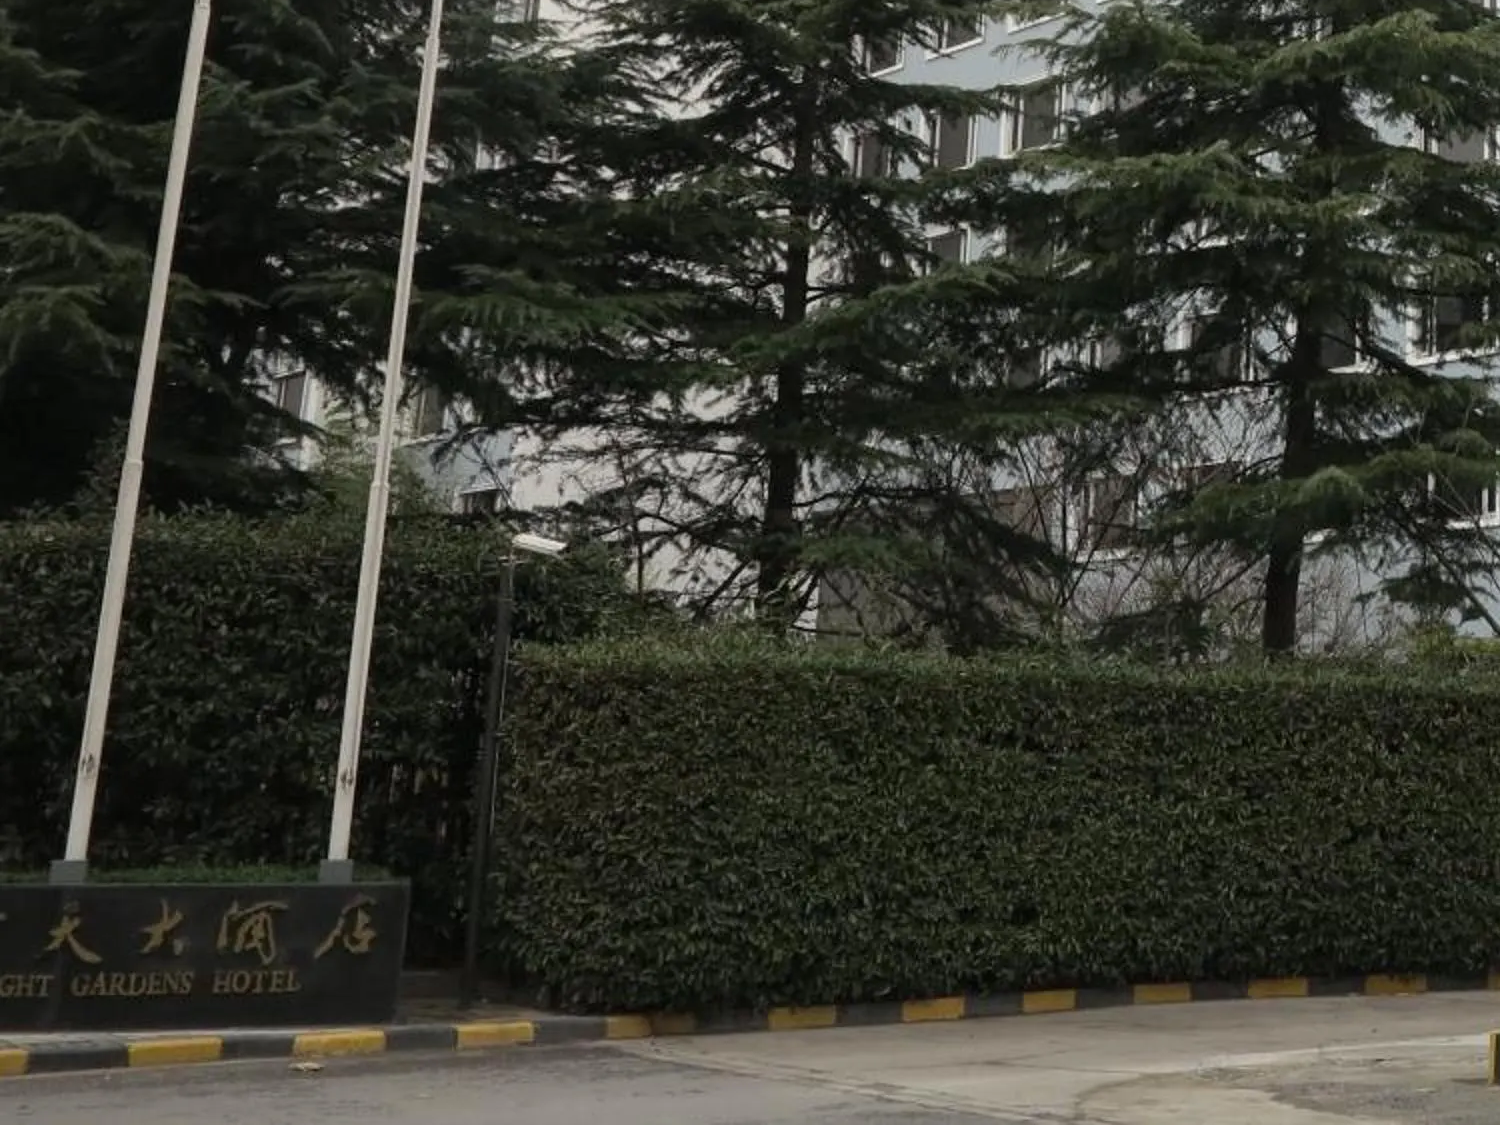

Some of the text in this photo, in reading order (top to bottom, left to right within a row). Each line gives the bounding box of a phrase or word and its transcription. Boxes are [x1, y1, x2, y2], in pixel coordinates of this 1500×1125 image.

[0, 893, 378, 965] 天大酒店
[70, 971, 195, 997] GARDENS
[212, 970, 301, 994] HOTEL
